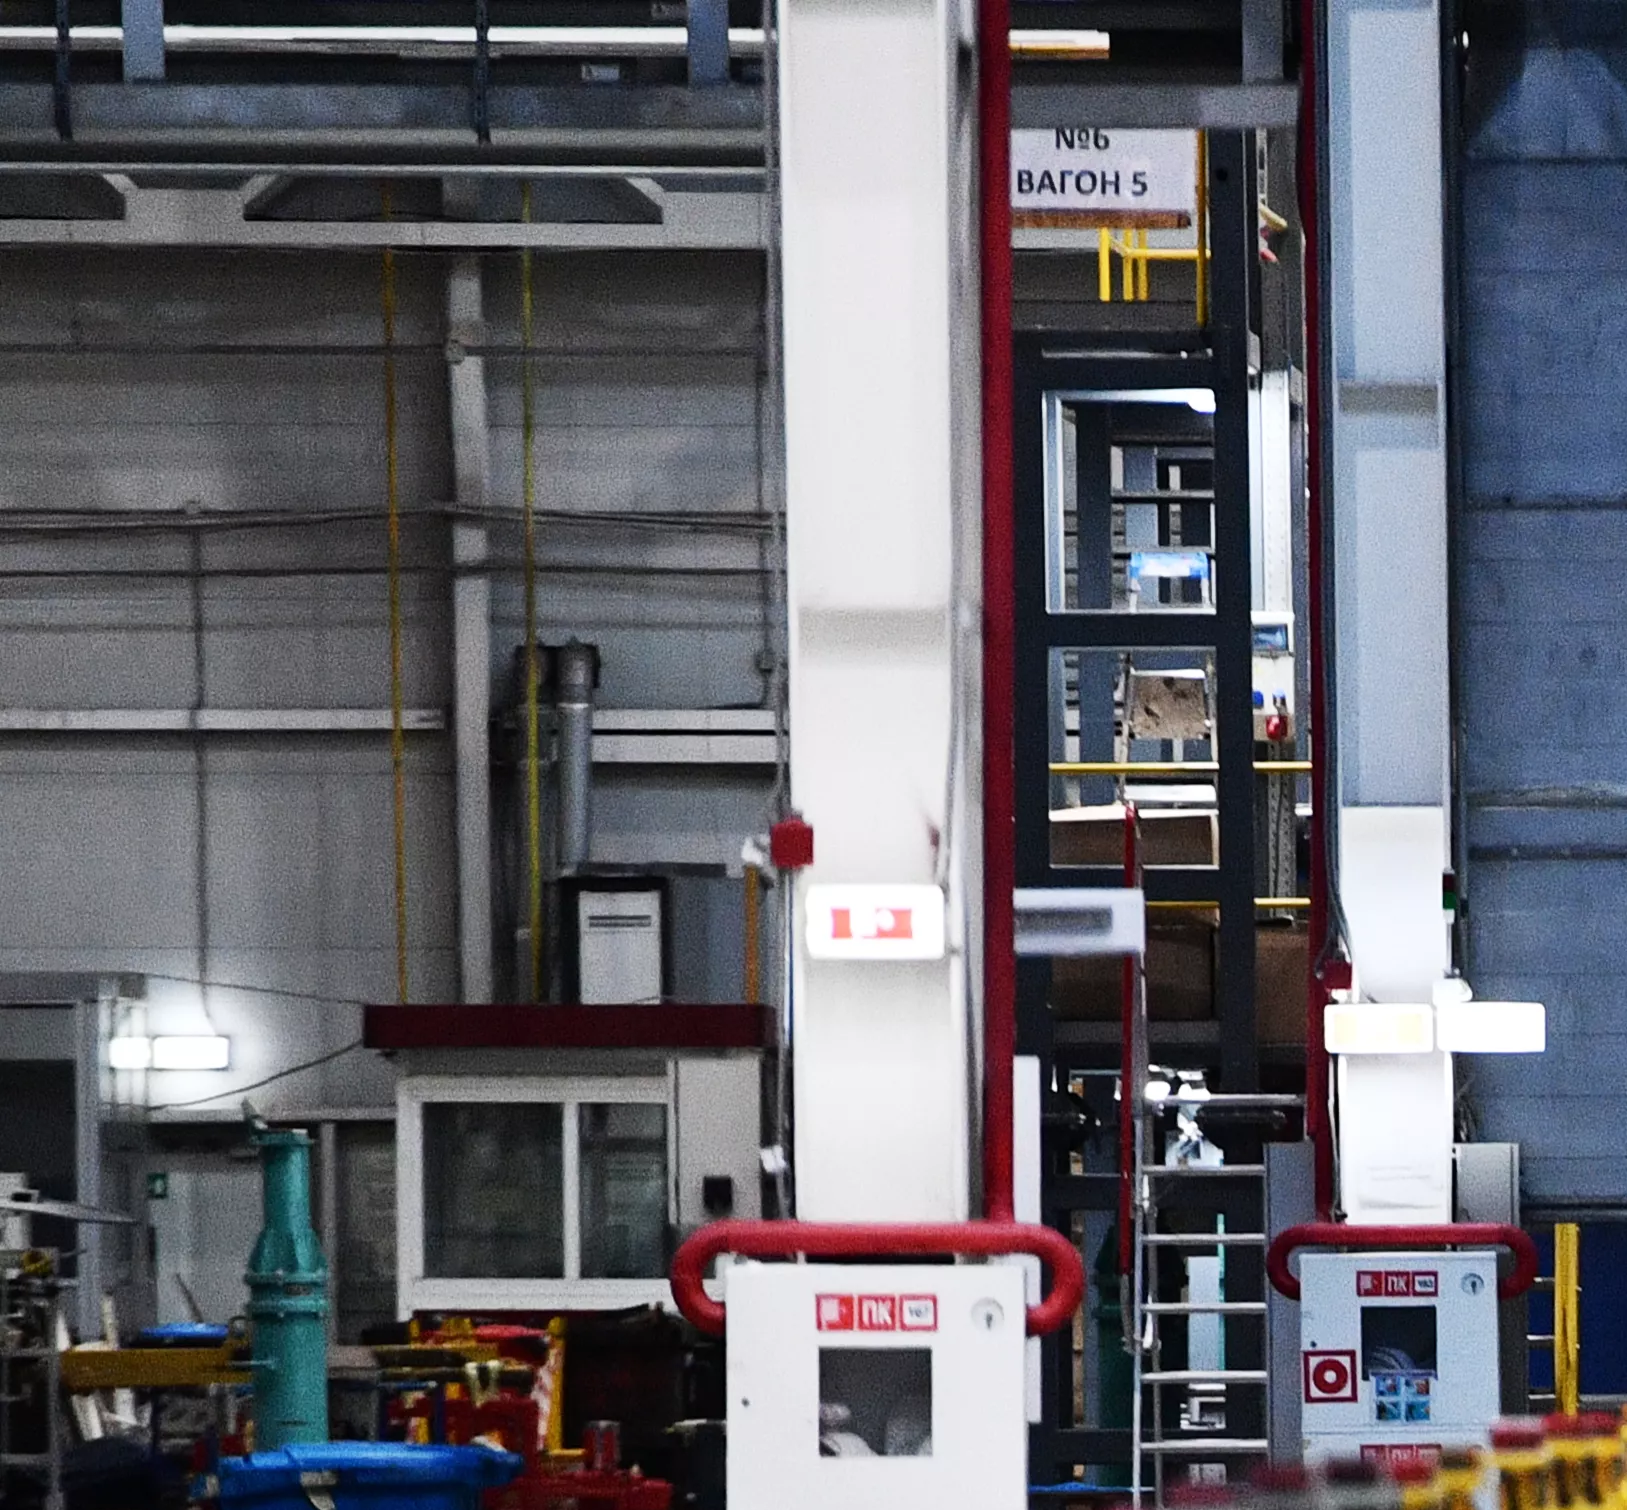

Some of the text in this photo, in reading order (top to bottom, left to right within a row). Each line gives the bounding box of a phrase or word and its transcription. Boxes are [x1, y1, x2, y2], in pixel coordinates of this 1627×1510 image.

[1055, 127, 1110, 150] №6
[1017, 169, 1148, 197] ВАГОН 5
